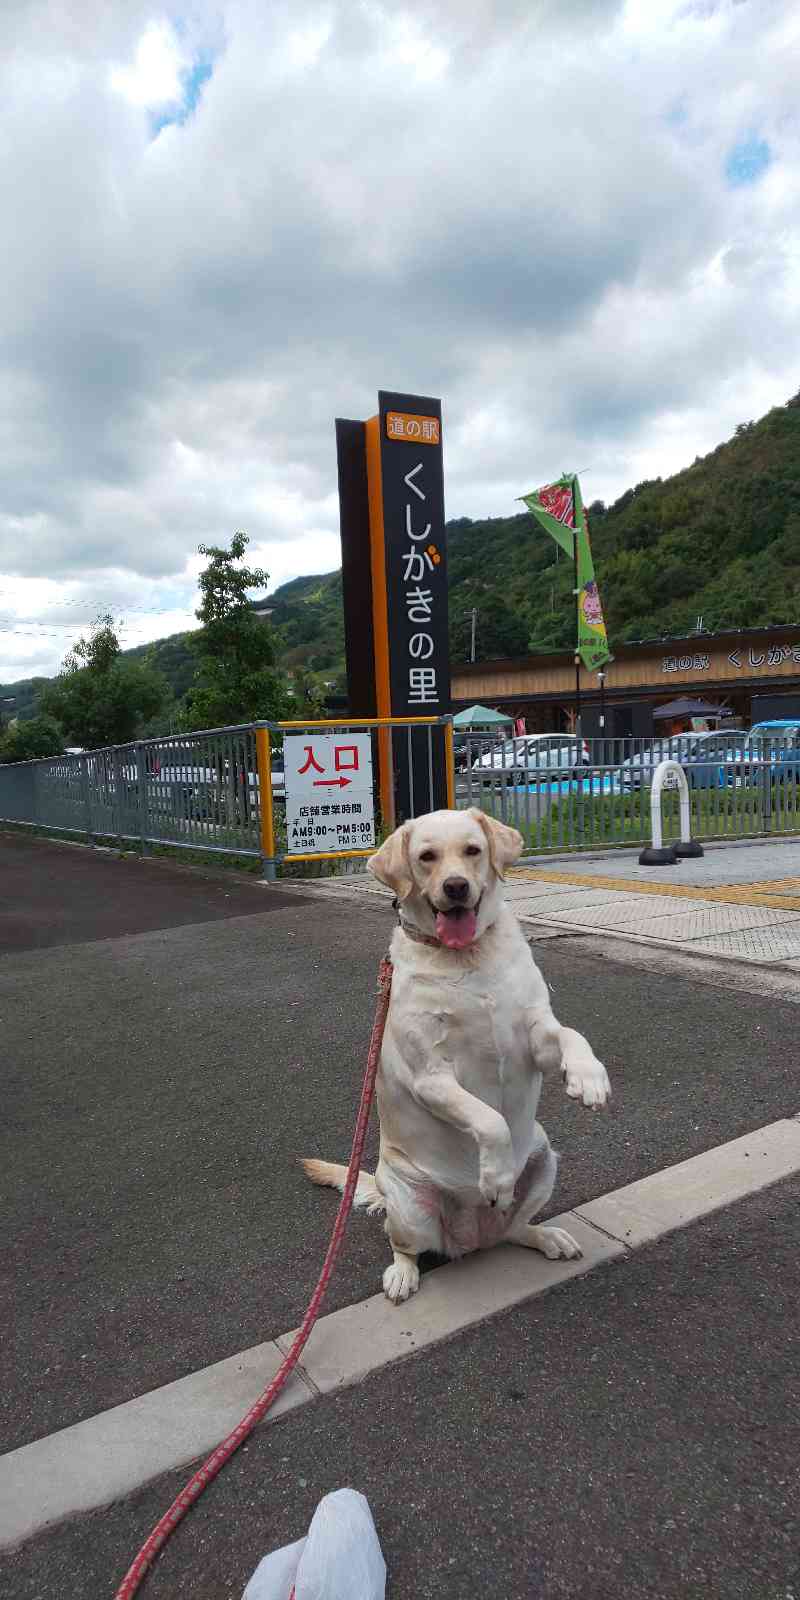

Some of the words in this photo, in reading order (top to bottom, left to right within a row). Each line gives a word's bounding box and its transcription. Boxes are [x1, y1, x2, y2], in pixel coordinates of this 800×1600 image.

[388, 415, 439, 442] 道の駅
[401, 462, 442, 705] くしがきの里
[662, 654, 709, 672] 道の駅
[297, 745, 360, 775] 入口
[299, 803, 362, 817] 店舗営業時間
